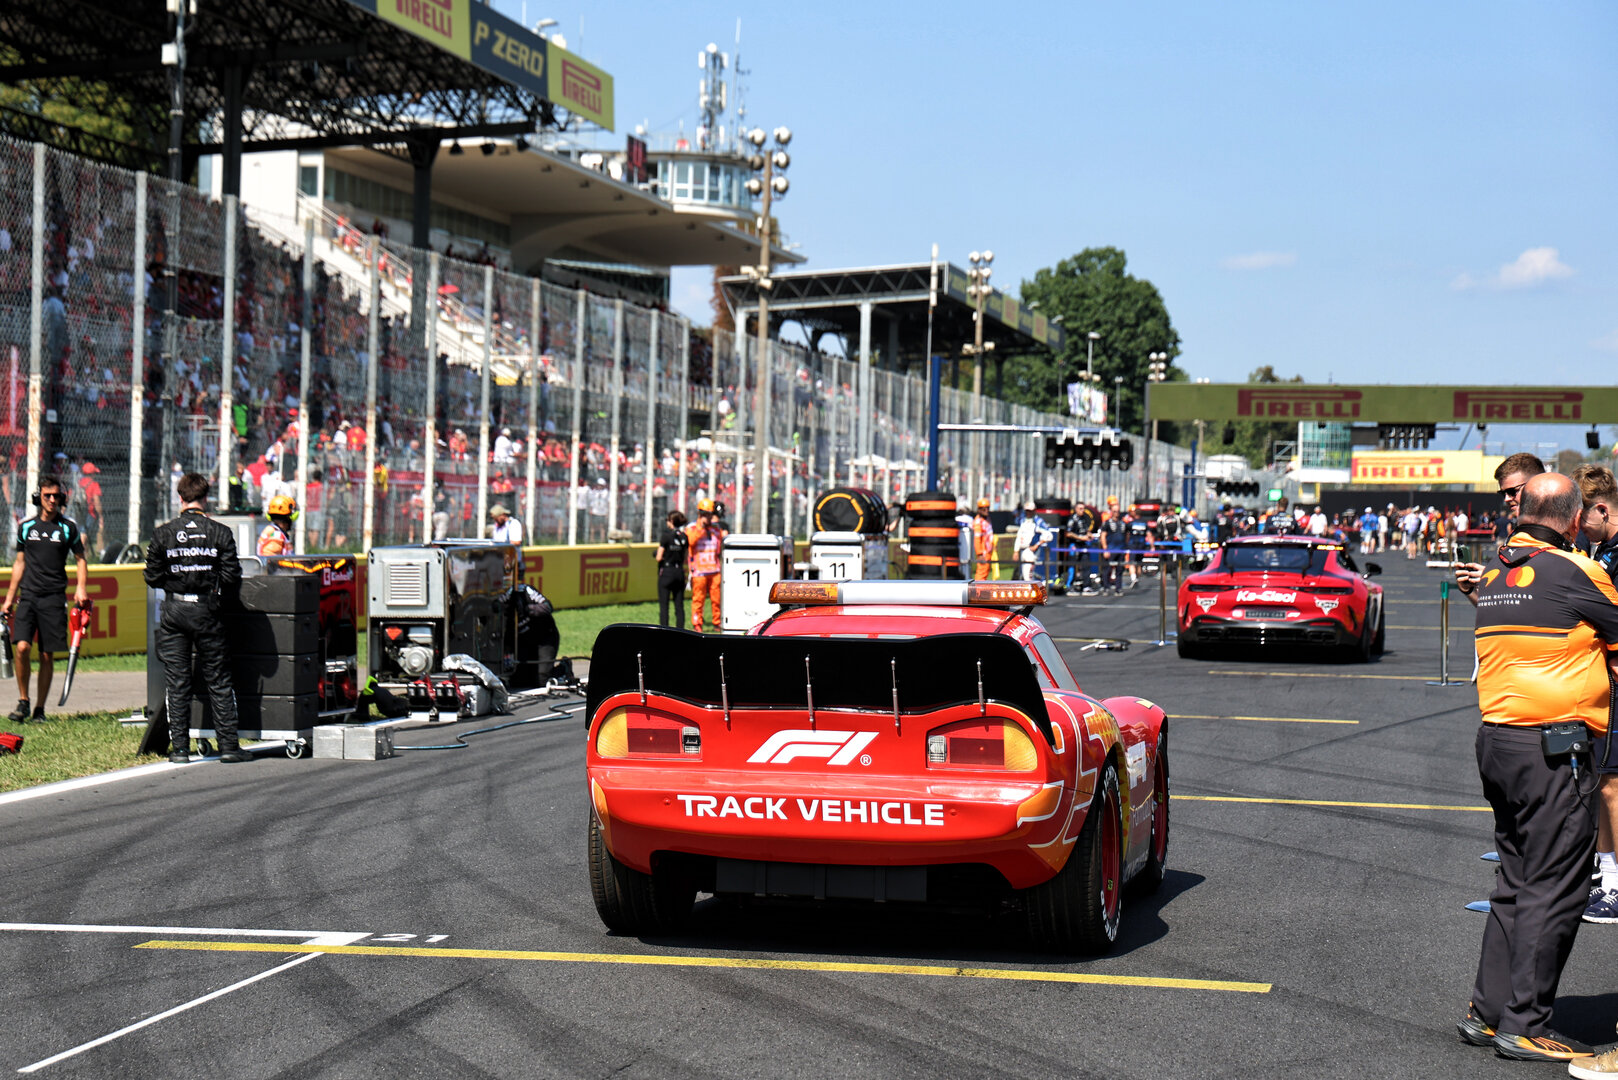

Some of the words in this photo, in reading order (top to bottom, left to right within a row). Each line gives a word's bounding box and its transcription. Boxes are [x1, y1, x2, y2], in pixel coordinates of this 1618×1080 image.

[474, 20, 489, 46] P
[492, 31, 544, 78] ZERO
[562, 58, 602, 116] PIRELLI
[1237, 389, 1362, 417] PIRELLI
[1454, 391, 1584, 420] PIRELLI
[1351, 457, 1444, 479] PIRELLI
[166, 546, 218, 558] PETRONAS
[579, 552, 629, 596] PIRELLI
[742, 569, 760, 587] 11
[829, 563, 846, 578] 11
[677, 794, 787, 820] TRACK
[797, 799, 944, 826] VEHICLE
[371, 933, 449, 942] 21
